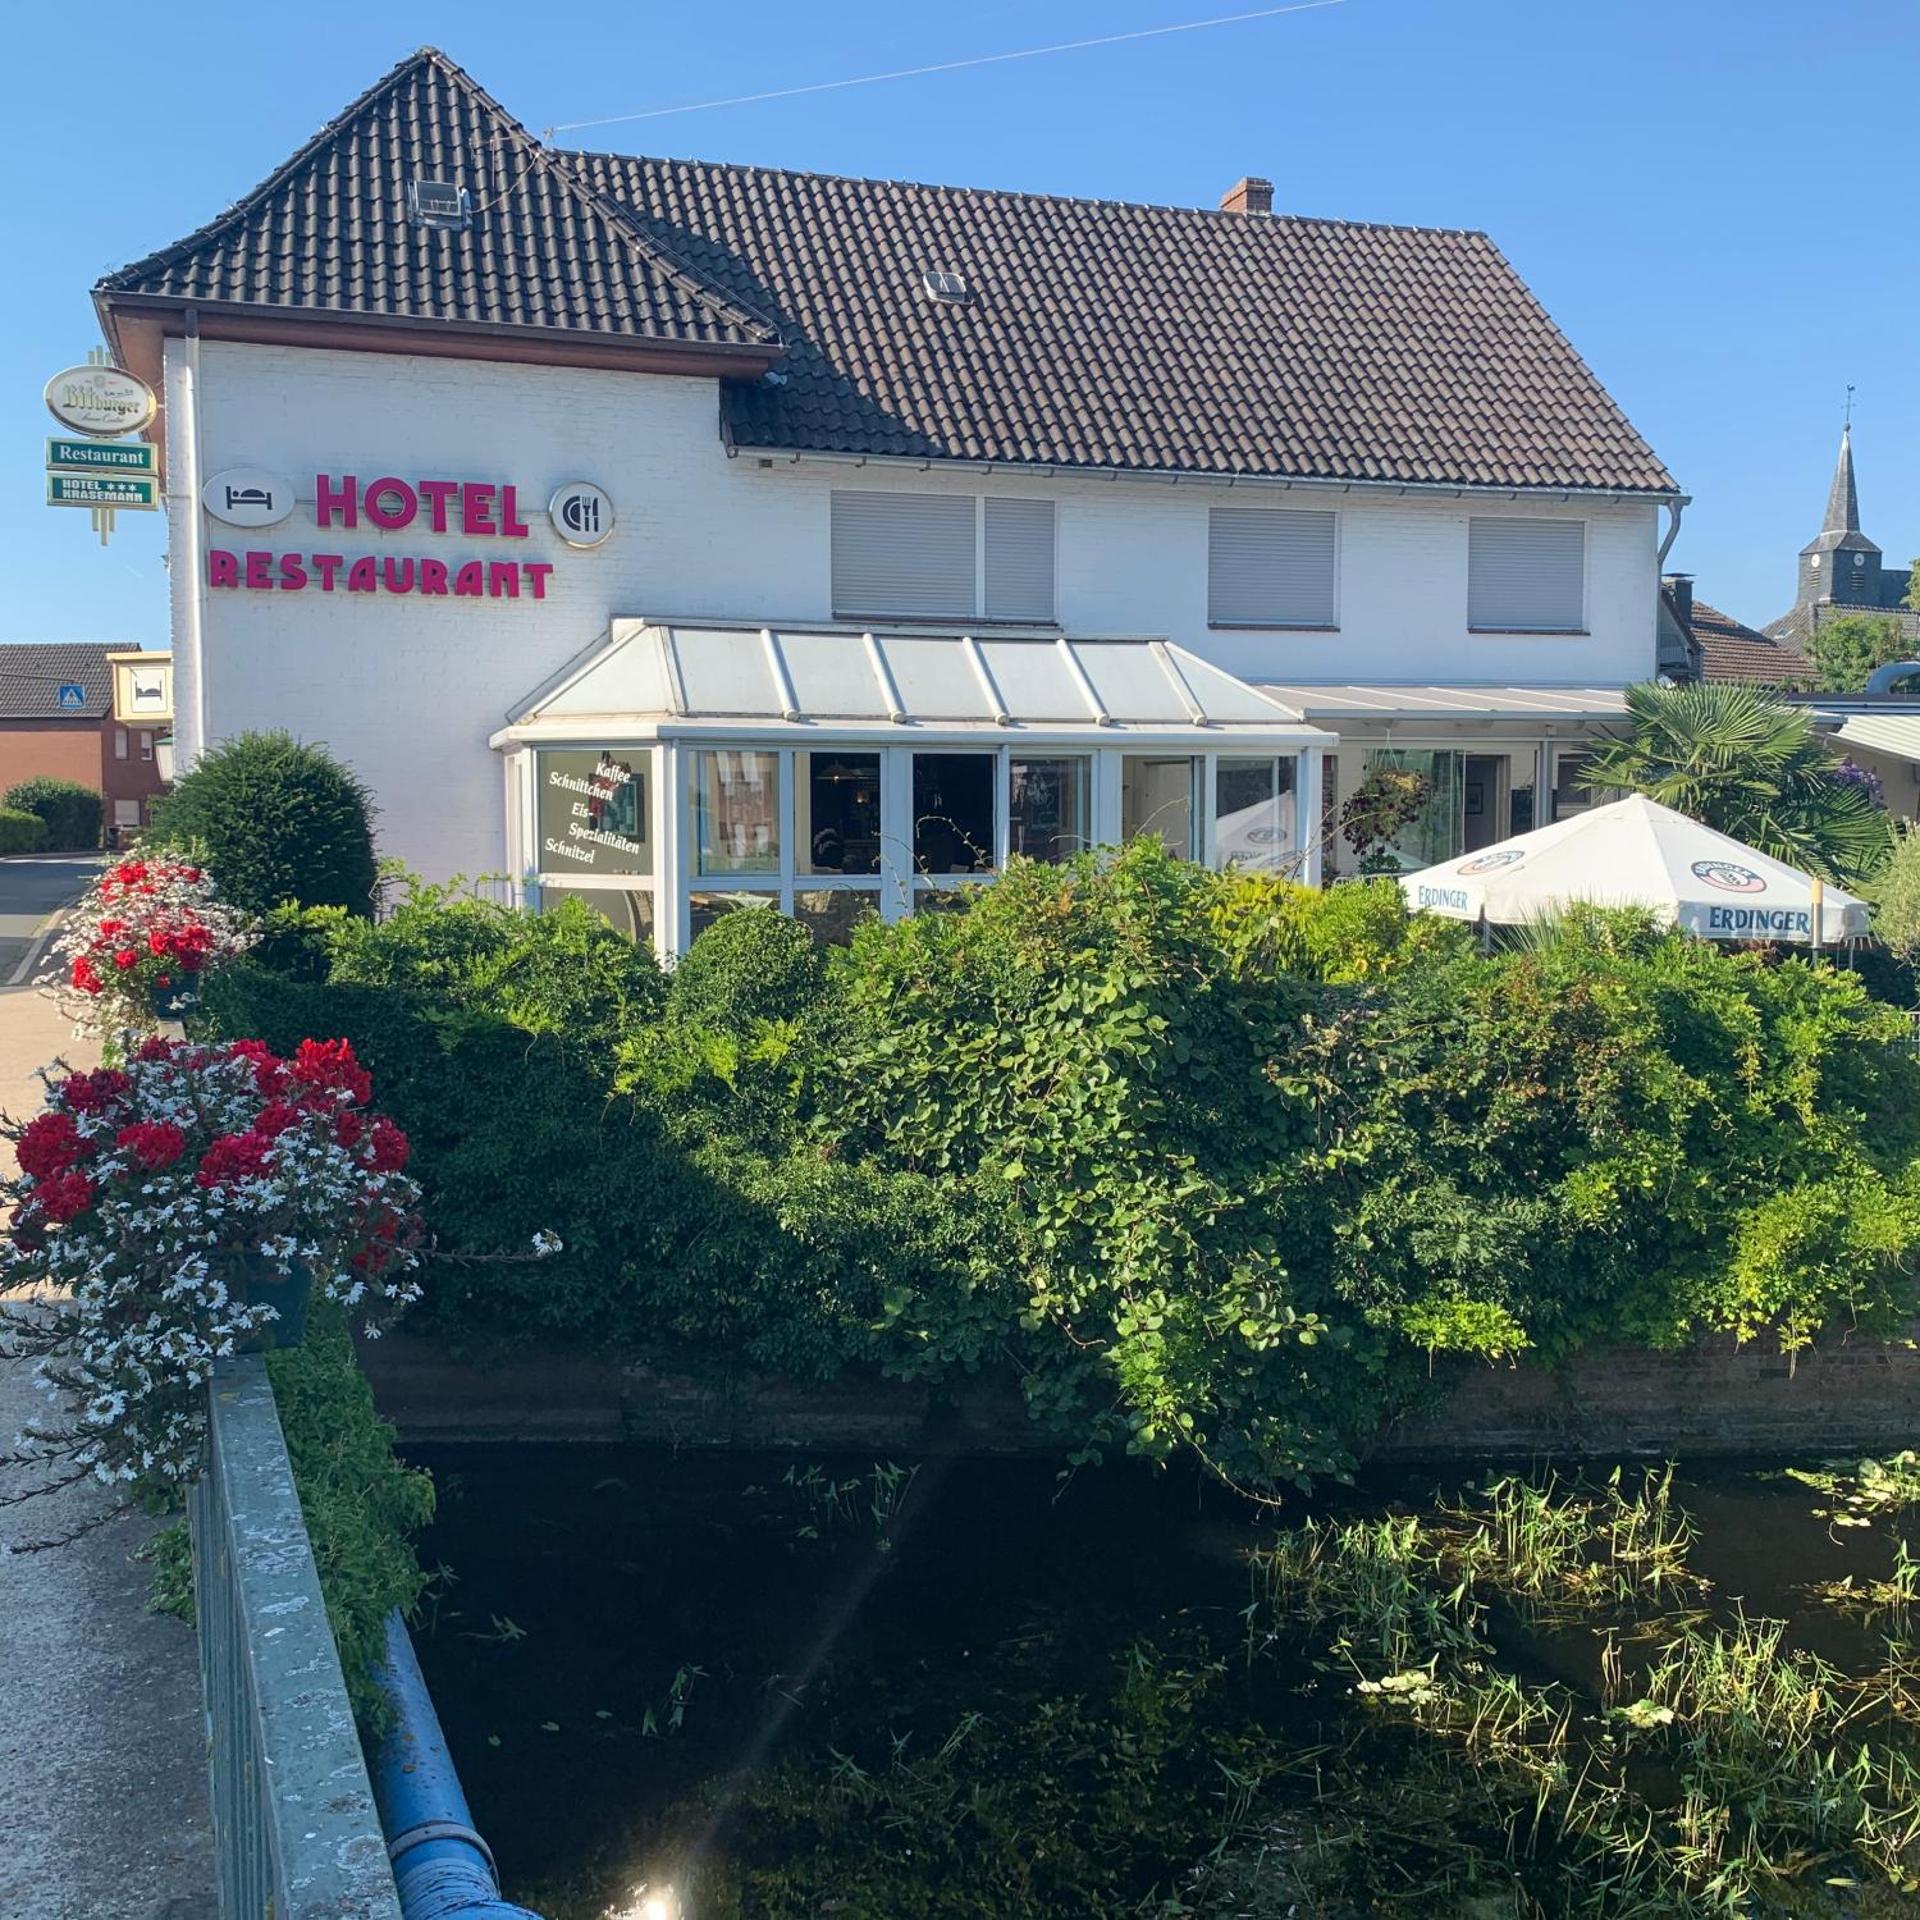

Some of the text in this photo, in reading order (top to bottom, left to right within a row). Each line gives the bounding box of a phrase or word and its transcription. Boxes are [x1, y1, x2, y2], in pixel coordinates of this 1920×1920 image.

[60, 445, 144, 465] Restaurant
[62, 479, 102, 490] HOTEL
[62, 490, 143, 503] KRASEMANN
[316, 474, 529, 538] HOTEL
[209, 549, 554, 599] RESTAURANT
[595, 762, 631, 783] Kaffee
[549, 771, 613, 801] Schnittchen
[571, 802, 594, 818] Eis-
[545, 838, 595, 864] Schnitzel
[568, 822, 640, 855] Spezialitäten
[1418, 885, 1468, 911] ERDINGER
[1709, 906, 1811, 934] ERDINGER
